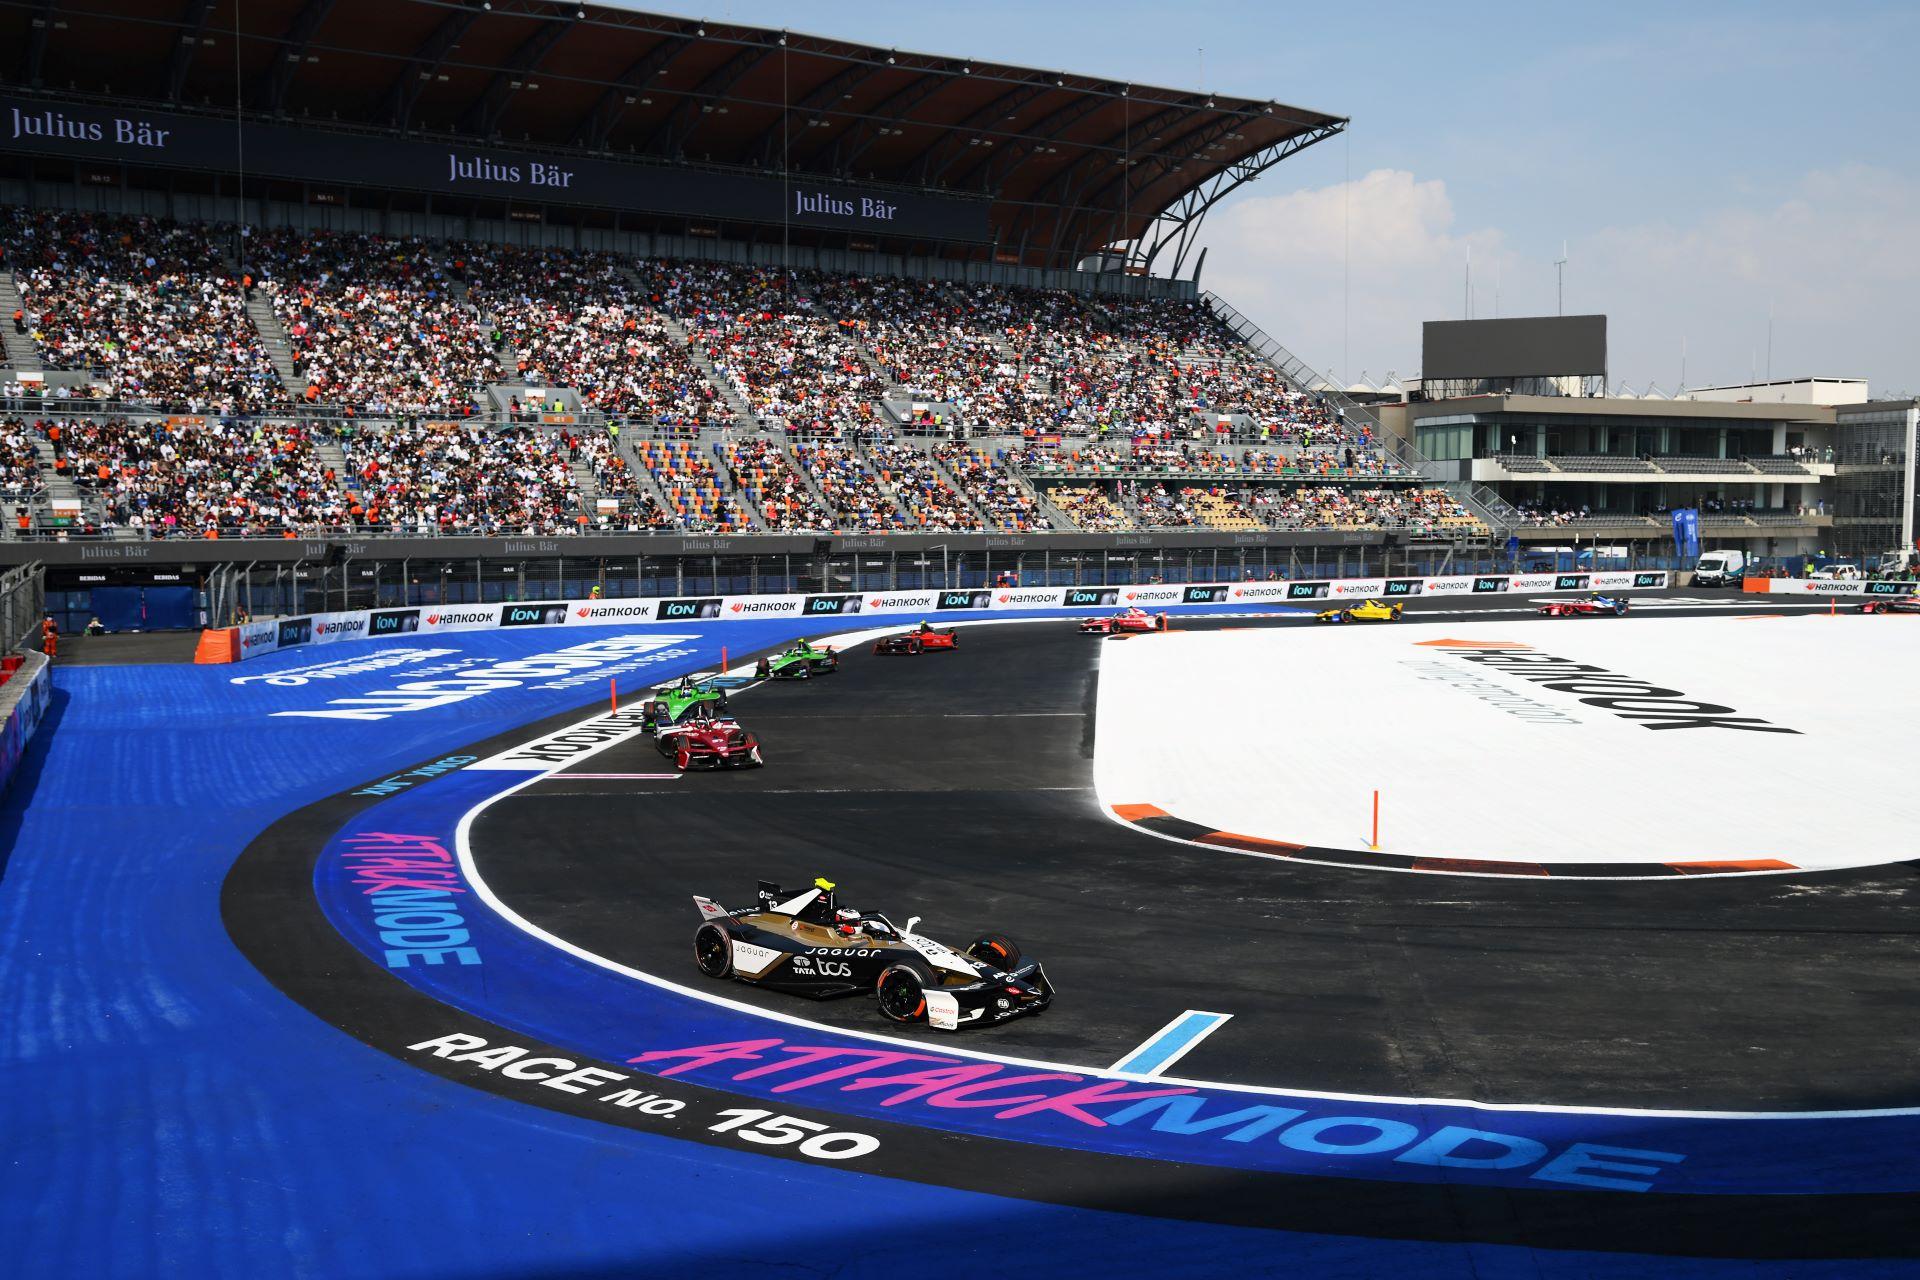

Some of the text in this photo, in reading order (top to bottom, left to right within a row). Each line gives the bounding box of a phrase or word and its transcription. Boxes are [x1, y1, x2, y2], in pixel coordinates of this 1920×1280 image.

[10, 108, 170, 147] Julius Bär
[449, 154, 573, 188] Julius Bär
[795, 190, 897, 220] Julius Bär
[81, 545, 150, 559] Julius Bär
[306, 543, 326, 556] Juli
[504, 540, 558, 553] Julius Bär
[682, 538, 731, 550] Julius Bär
[842, 537, 886, 549] Julius Bär
[985, 536, 1025, 547] Julius Bär
[455, 634, 703, 678] MEXICO
[267, 679, 523, 720] CITY
[1453, 683, 1583, 724] emotion
[371, 889, 482, 968] MODE
[792, 967, 816, 975] TATA
[406, 1033, 881, 1160] RACE NO. 150
[1103, 1092, 1691, 1193] MODE
